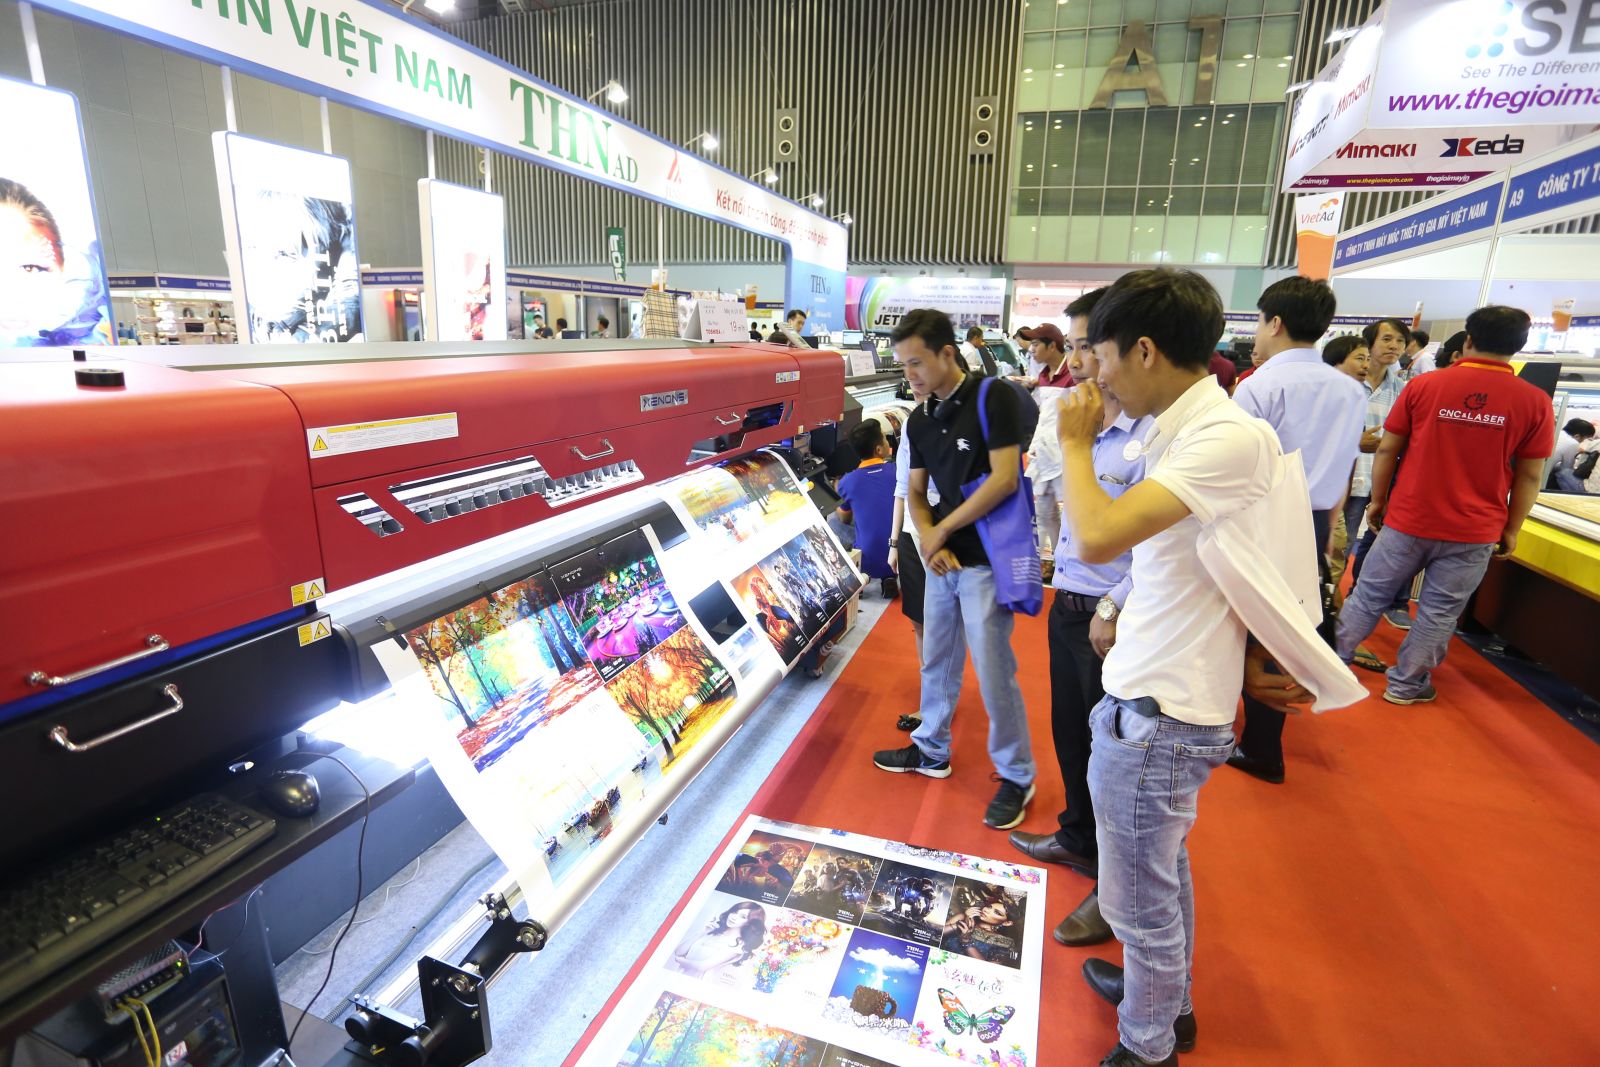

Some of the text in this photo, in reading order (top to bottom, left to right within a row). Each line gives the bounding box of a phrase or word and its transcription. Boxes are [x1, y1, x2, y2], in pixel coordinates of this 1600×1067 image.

[284, 0, 383, 77] VIỆT
[394, 43, 473, 109] NAM
[1461, 64, 1494, 80] See
[1497, 62, 1527, 78] The
[510, 78, 638, 184] THN AD
[1346, 176, 1414, 185] www.thegioimayin.com
[1509, 188, 1524, 208] A9
[1537, 173, 1570, 199] CÔNG
[1572, 165, 1590, 189] TY
[716, 189, 731, 210] Kết
[1400, 219, 1418, 241] THIẾT
[1450, 206, 1468, 228] VIỆT
[1468, 200, 1488, 221] NAM
[874, 314, 903, 326] JET
